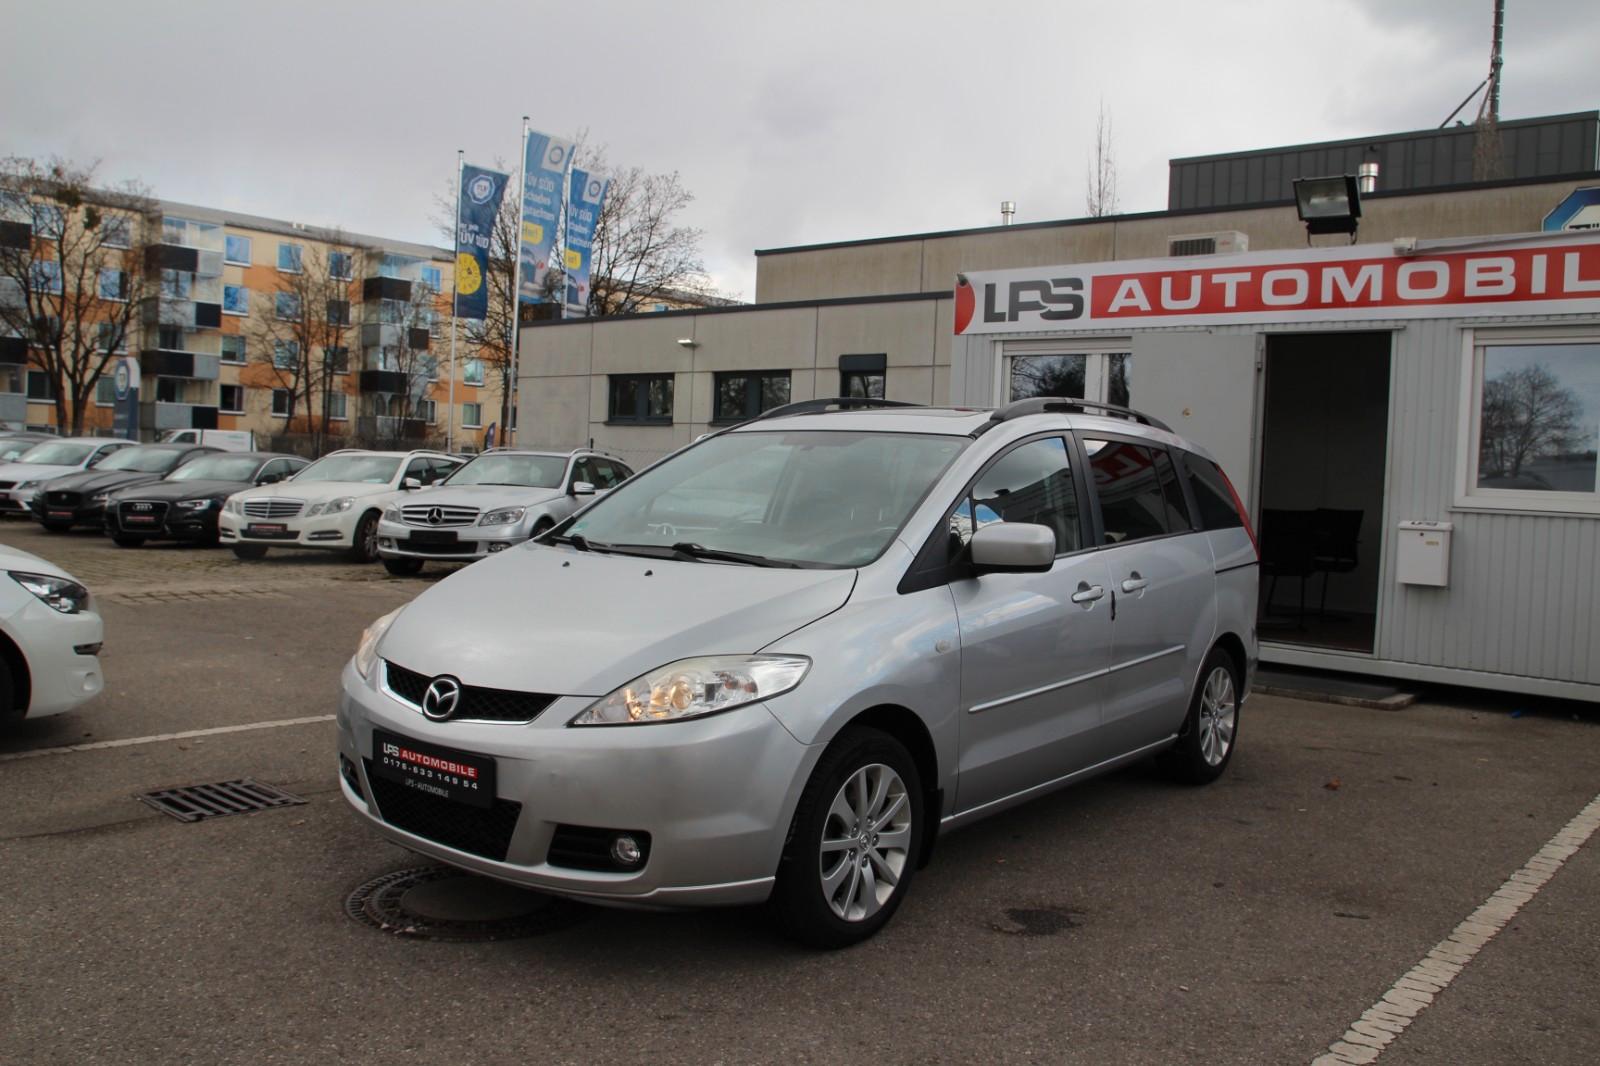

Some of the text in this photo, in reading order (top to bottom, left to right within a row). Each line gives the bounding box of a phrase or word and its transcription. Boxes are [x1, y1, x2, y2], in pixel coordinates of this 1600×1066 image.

[983, 252, 1600, 323] LPS AUTOMOBIL
[383, 742, 476, 777] LPS AUTOMOBILE
